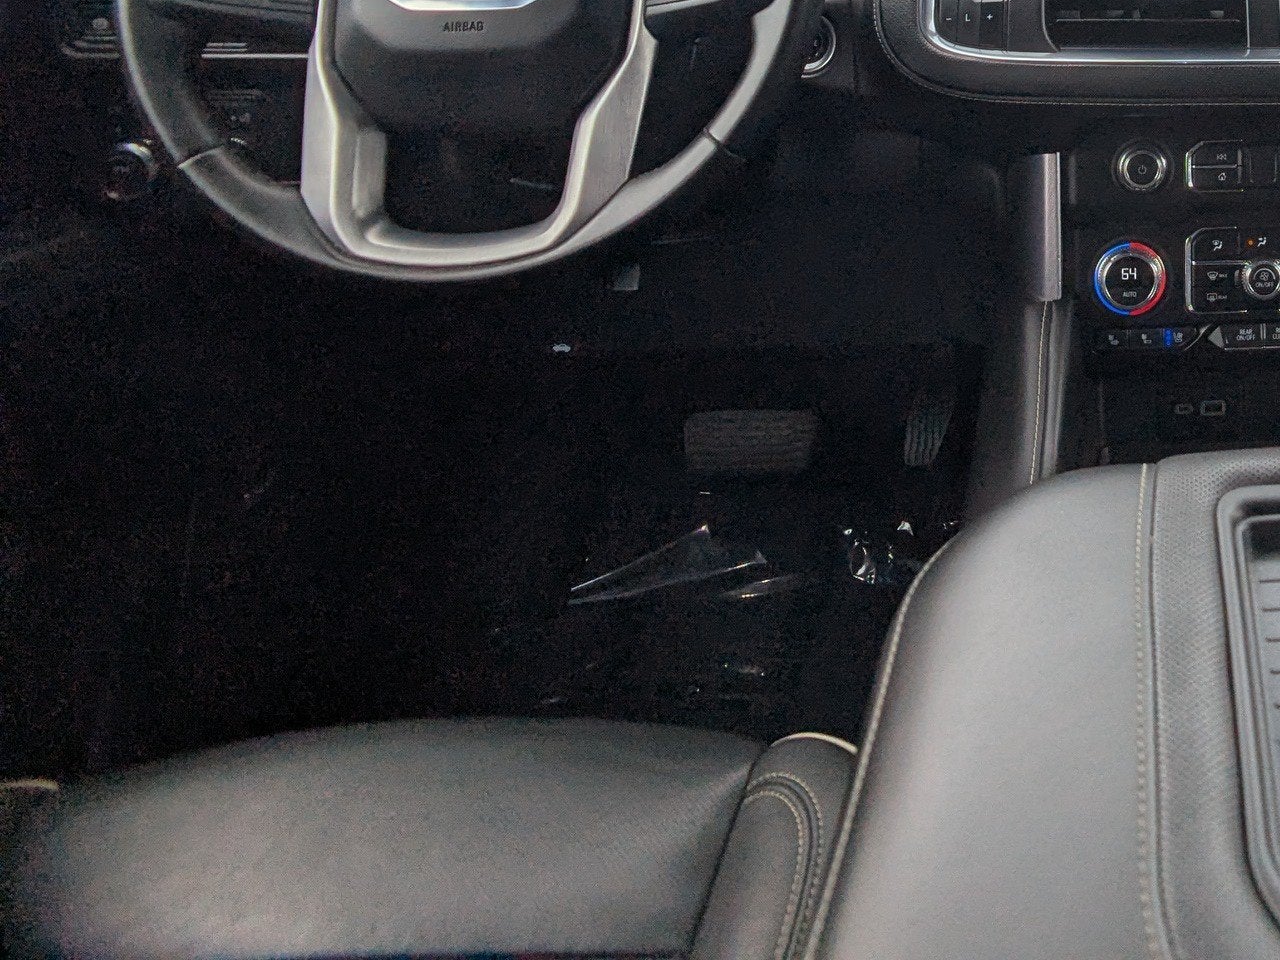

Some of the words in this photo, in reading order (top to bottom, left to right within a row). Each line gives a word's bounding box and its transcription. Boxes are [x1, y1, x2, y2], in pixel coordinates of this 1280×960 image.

[965, 14, 971, 22] L
[442, 21, 484, 32] AIRBAG
[1121, 267, 1137, 280] 64
